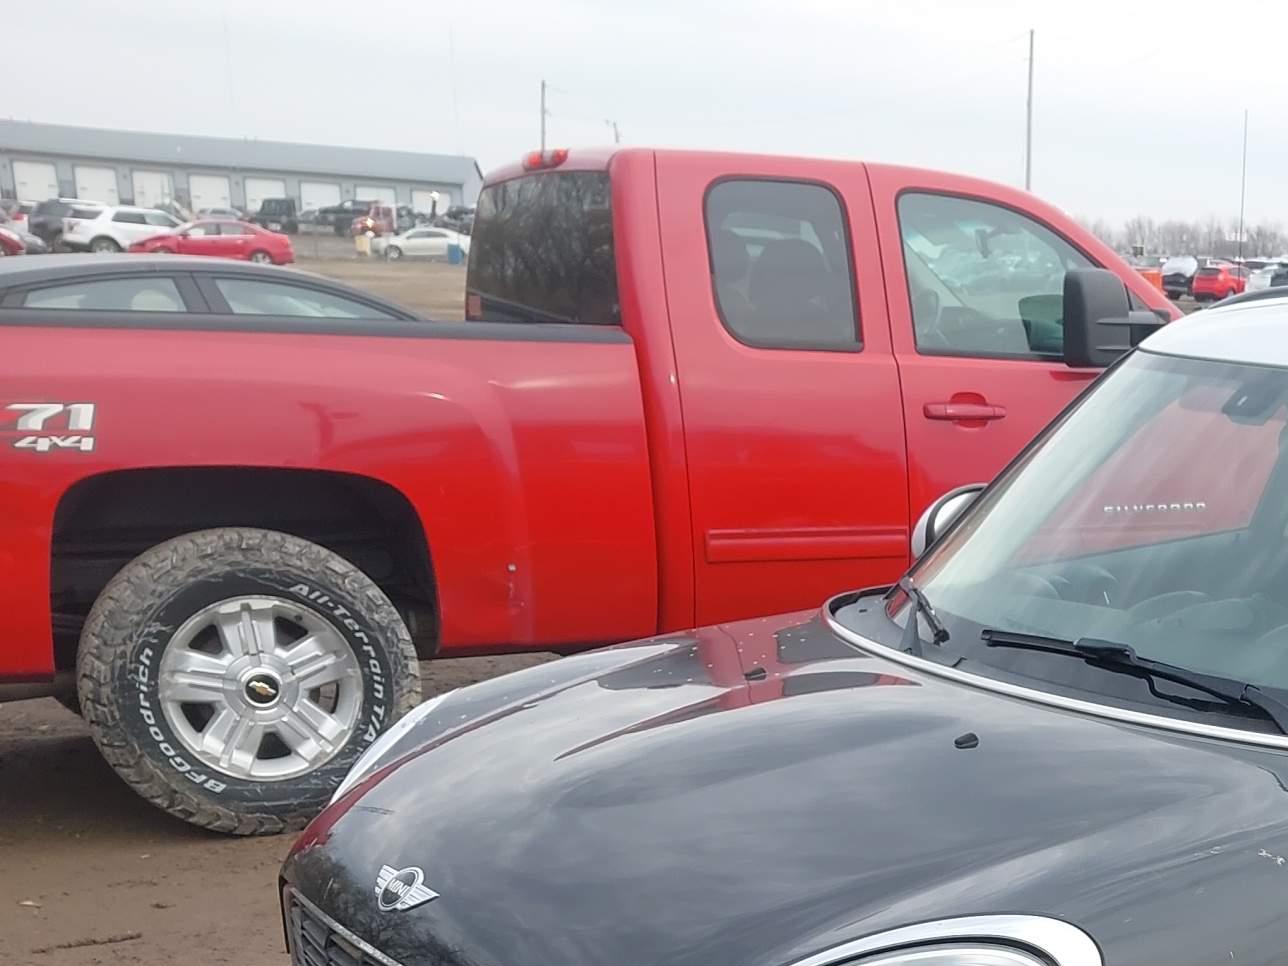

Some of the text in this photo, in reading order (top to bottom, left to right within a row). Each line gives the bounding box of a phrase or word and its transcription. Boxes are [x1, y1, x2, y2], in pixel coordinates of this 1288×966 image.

[136, 646, 227, 794] BFGoodrich
[363, 704, 386, 743] T/A
[387, 878, 411, 897] MINI
